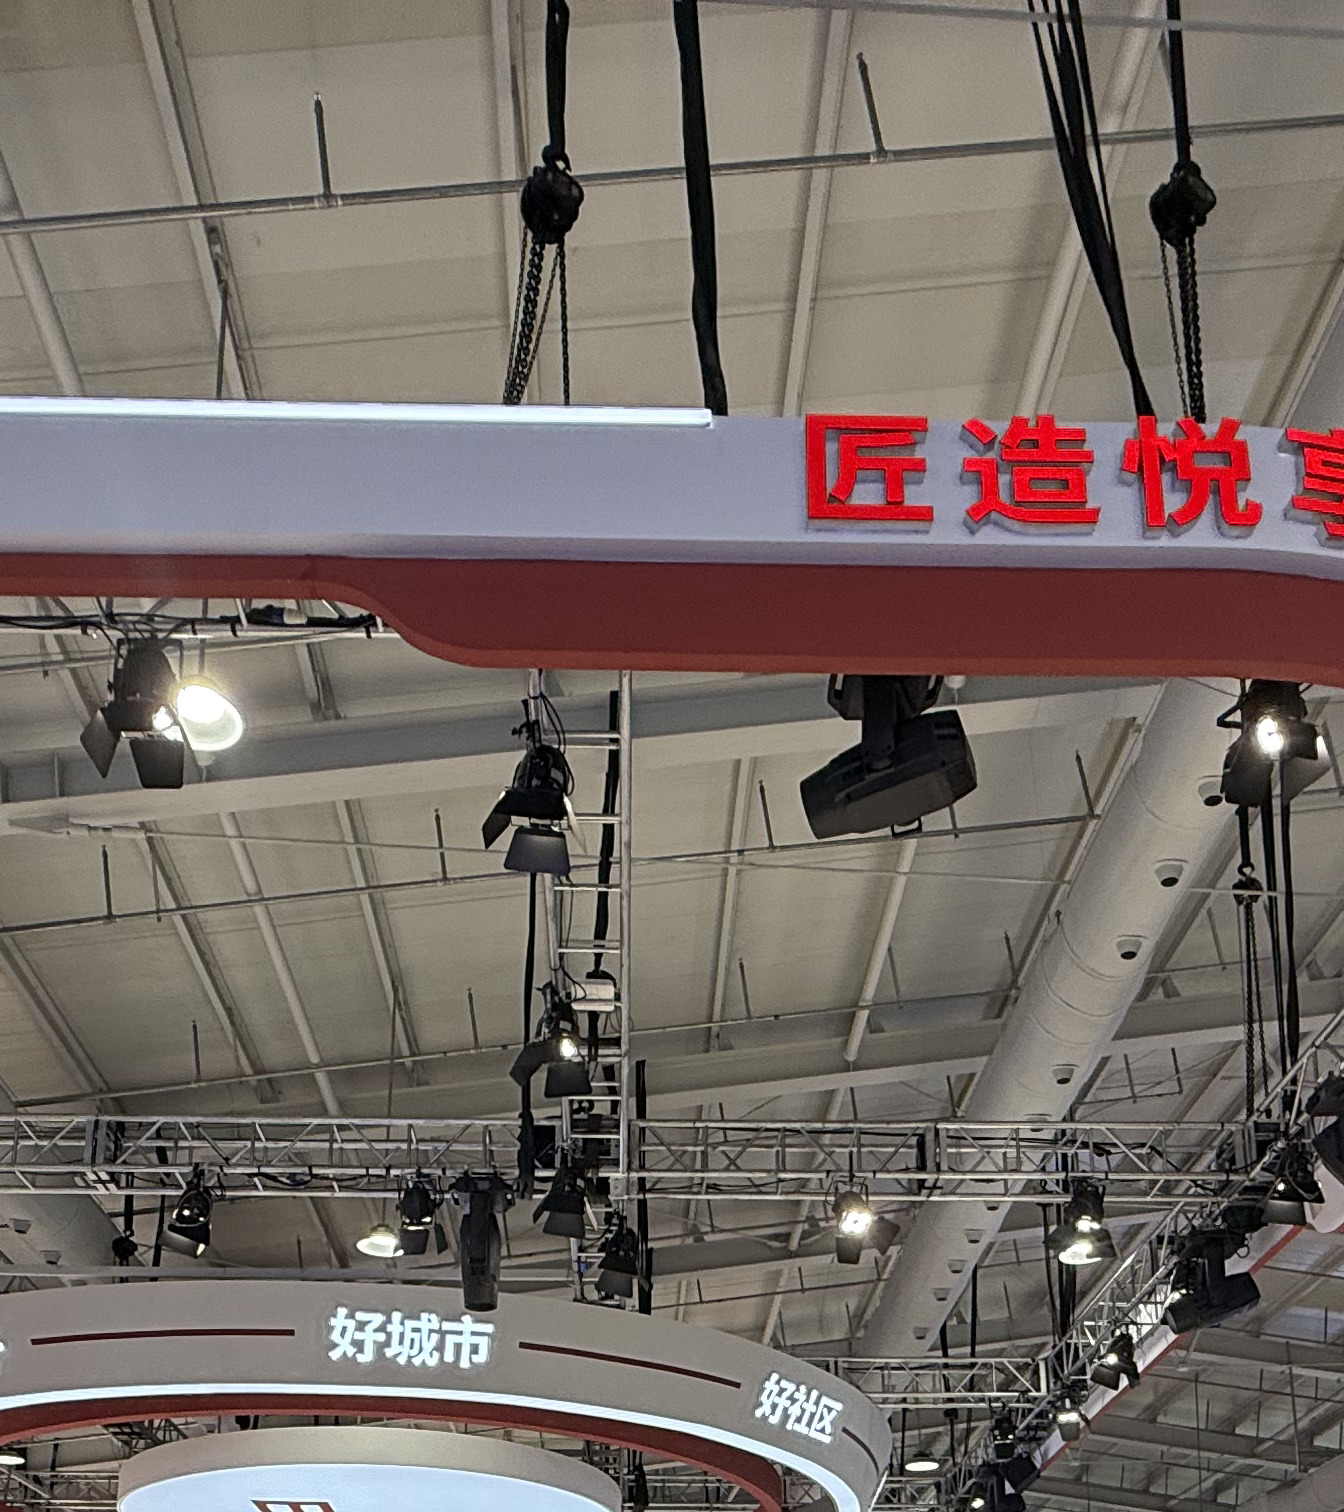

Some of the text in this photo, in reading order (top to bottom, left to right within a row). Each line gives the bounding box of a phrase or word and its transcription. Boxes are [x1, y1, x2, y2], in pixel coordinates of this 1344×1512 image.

[328, 1305, 495, 1370] 好城市
[754, 1370, 845, 1446] 好社区
